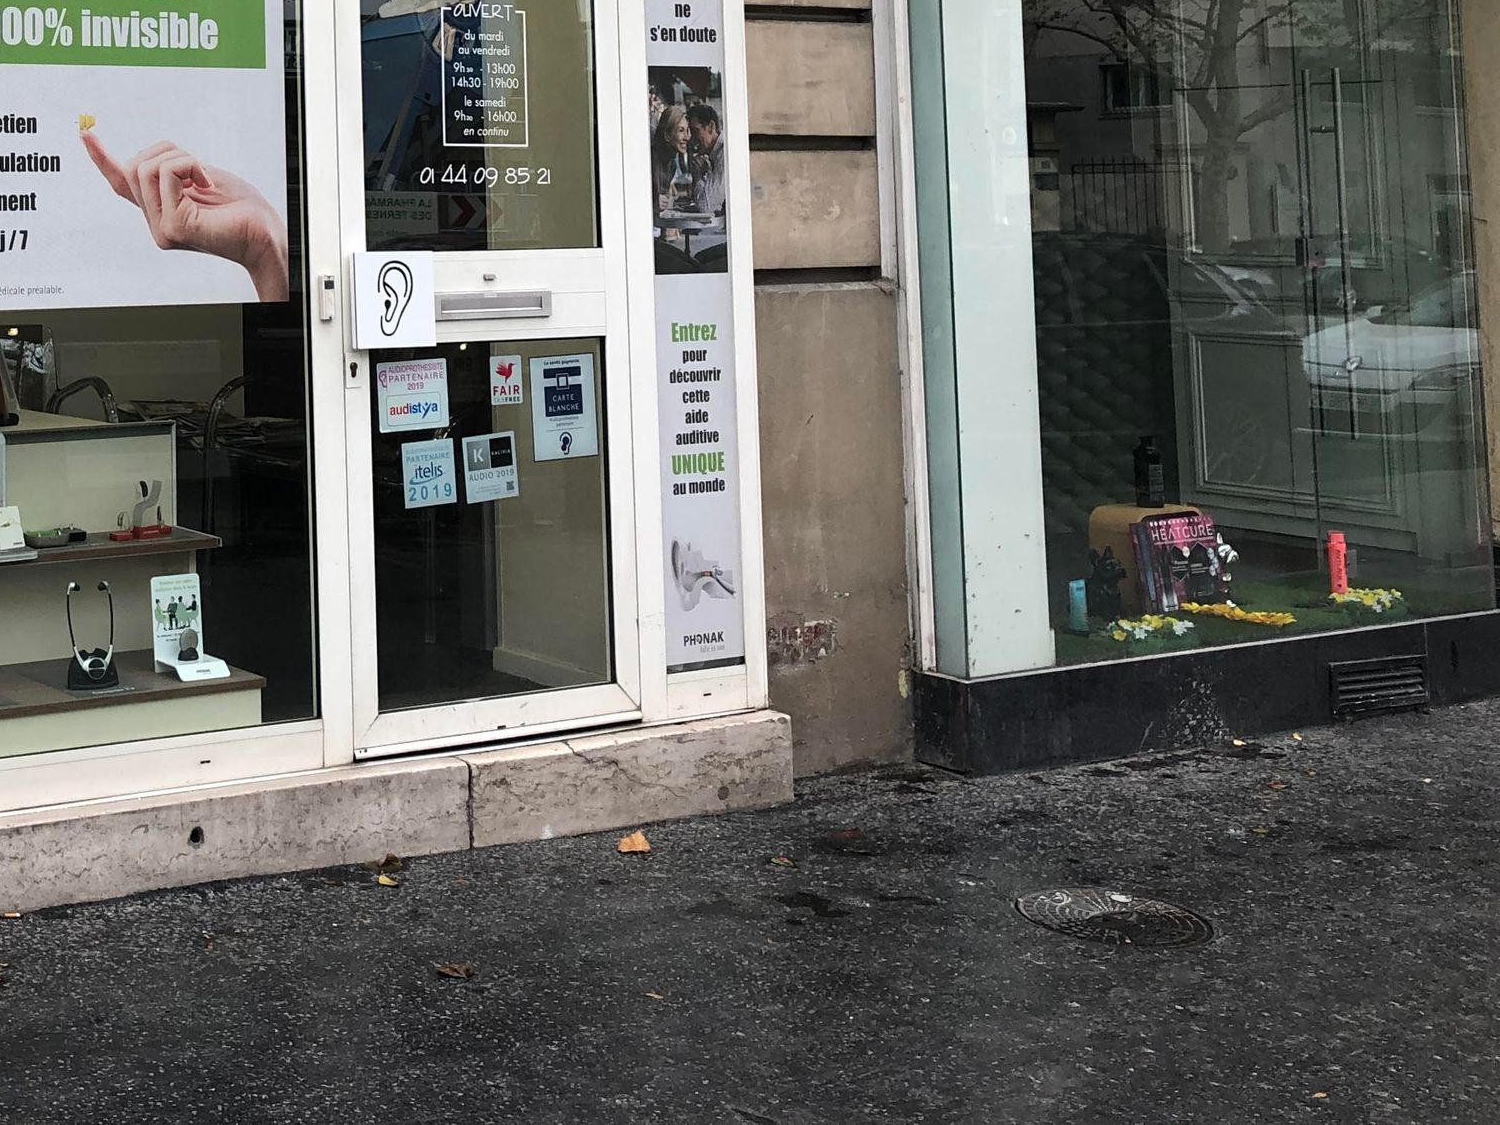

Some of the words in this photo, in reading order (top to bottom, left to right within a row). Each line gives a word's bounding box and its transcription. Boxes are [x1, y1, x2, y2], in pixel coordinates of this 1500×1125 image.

[453, 1, 513, 22] OUVERT
[674, 3, 691, 18] ne
[81, 9, 220, 50] invisible
[464, 31, 476, 41] du
[478, 31, 504, 42] mardi
[649, 25, 677, 42] s'en
[679, 26, 717, 43] doute
[458, 47, 470, 56] au
[472, 45, 510, 57] vendredi
[486, 62, 516, 74] 13h00
[451, 76, 481, 88] 14h30
[489, 77, 519, 89] 19h00
[464, 96, 473, 107] le
[474, 96, 506, 107] samedi
[487, 110, 517, 123] 16h00
[463, 127, 475, 137] en
[477, 126, 509, 137] continu
[419, 166, 435, 184] 01
[440, 164, 467, 185] 44
[473, 166, 498, 187] 09
[504, 167, 530, 185] 85
[536, 167, 551, 185] 21
[27, 284, 65, 297] préalable.
[671, 322, 717, 342] Entrez
[682, 348, 708, 364] pour
[388, 371, 445, 383] PARTENAIRE
[669, 367, 722, 384] découvrir
[407, 381, 425, 391] 2019
[492, 384, 520, 396] FAIR
[552, 393, 575, 402] CARTE
[682, 388, 711, 404] cette
[389, 401, 438, 419] audistya
[548, 403, 580, 413] BLANCHE
[684, 408, 709, 424] aide
[675, 429, 720, 446] auditive
[473, 448, 485, 463] K
[671, 451, 725, 475] UNIQUE
[415, 461, 444, 480] itelis
[468, 471, 494, 482] AUDIO
[496, 468, 515, 478] 2019
[673, 481, 687, 496] au
[688, 478, 726, 494] monde
[1151, 524, 1213, 541] HEATCURE
[683, 631, 725, 647] PHONAK
